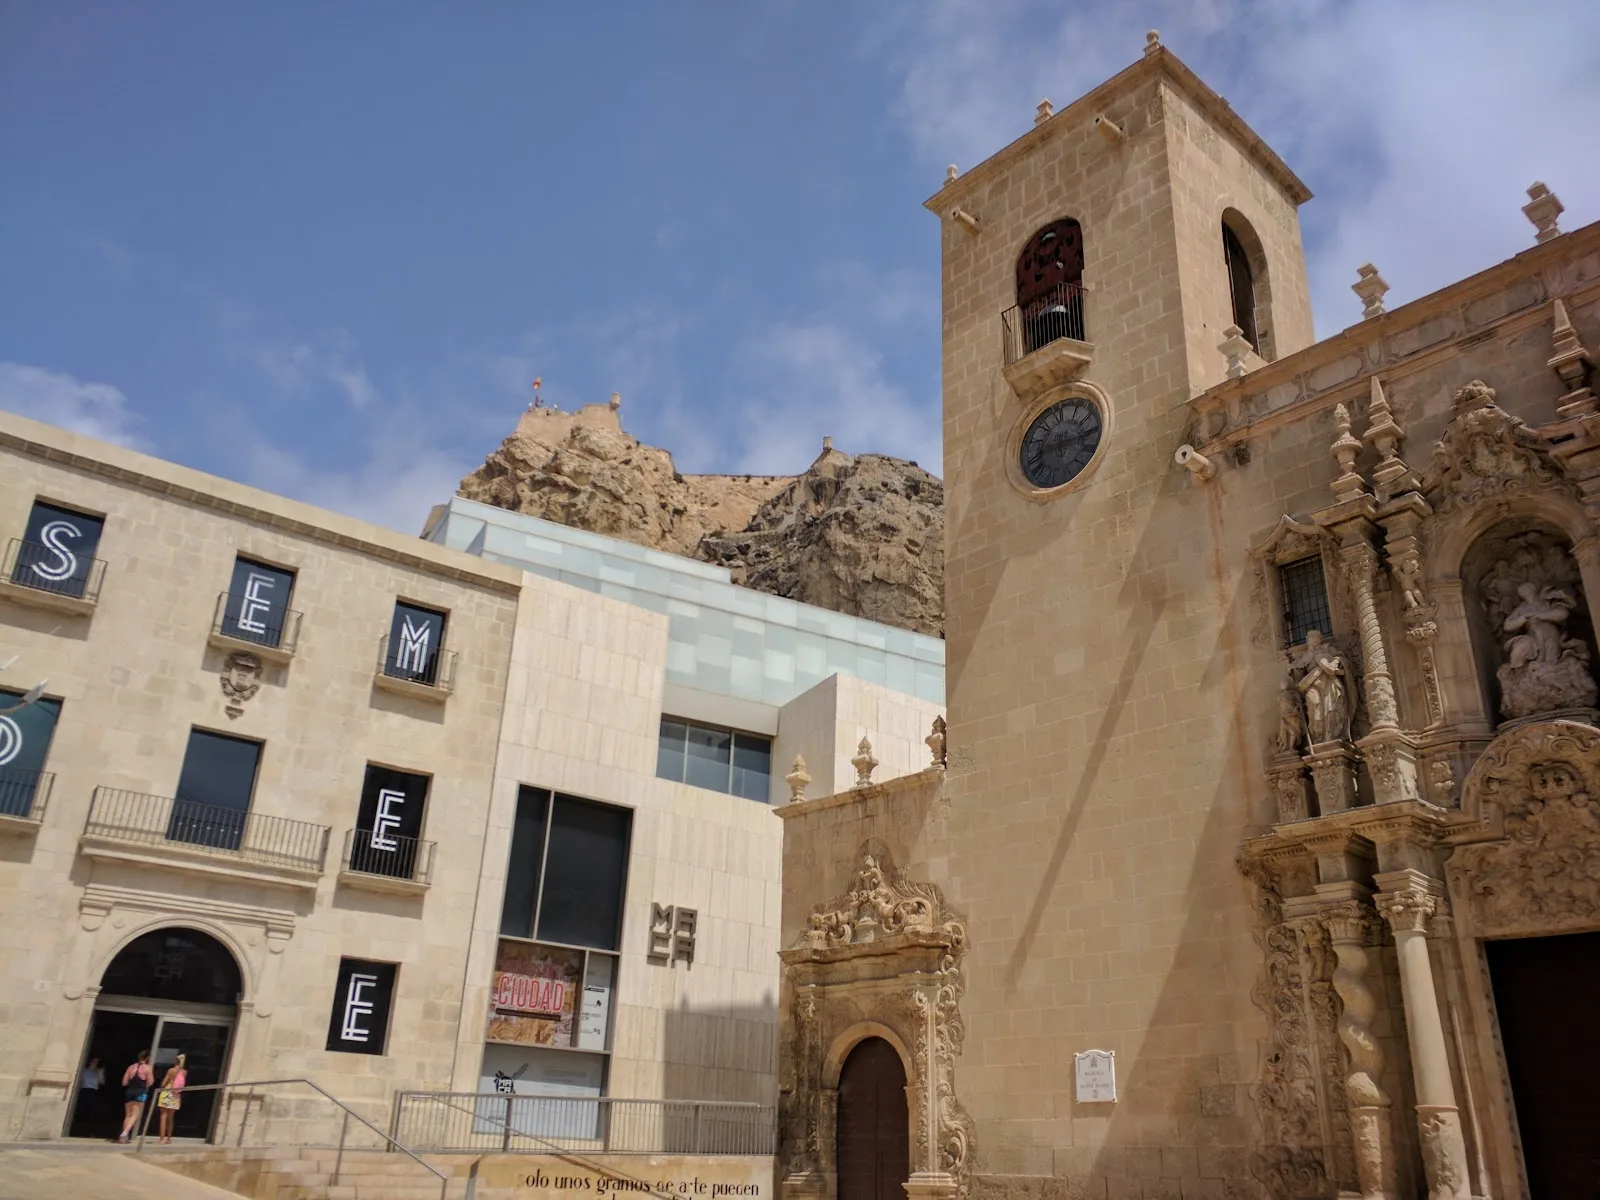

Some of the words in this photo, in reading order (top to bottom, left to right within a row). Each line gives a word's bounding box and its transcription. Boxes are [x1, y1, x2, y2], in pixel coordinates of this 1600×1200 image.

[31, 520, 82, 582] S
[238, 572, 276, 635] E
[395, 614, 431, 673] M
[370, 788, 406, 852] E
[340, 972, 378, 1042] E
[497, 975, 565, 1013] CIUDAD
[554, 1176, 591, 1190] unos
[596, 1175, 651, 1195] gramos
[678, 1177, 708, 1195] ate
